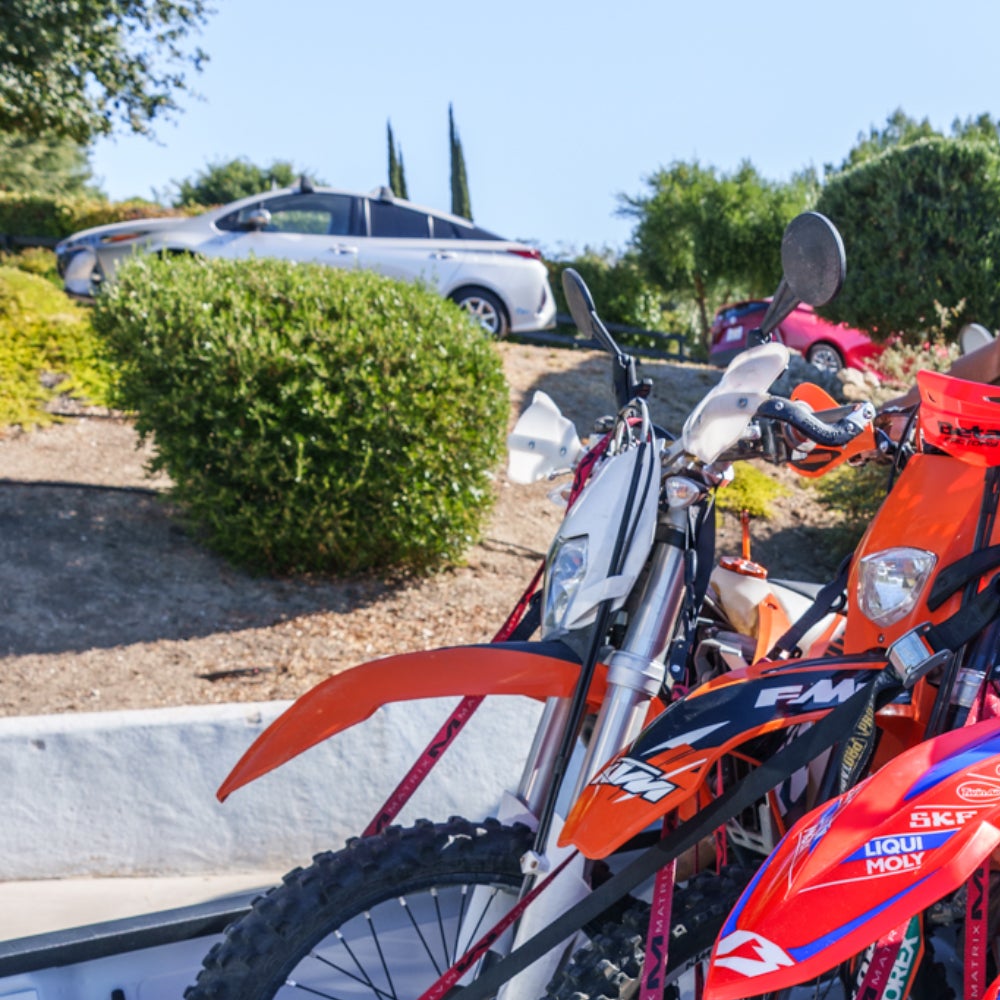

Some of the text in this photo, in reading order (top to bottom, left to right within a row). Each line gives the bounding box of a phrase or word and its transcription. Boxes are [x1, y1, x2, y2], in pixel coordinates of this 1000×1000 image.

[387, 759, 429, 813] MATRIX
[909, 809, 978, 829] SKF
[864, 836, 924, 858] LIQUI
[865, 851, 926, 876] MOLY
[871, 928, 897, 986] MATR
[969, 925, 981, 998] MATRIX
